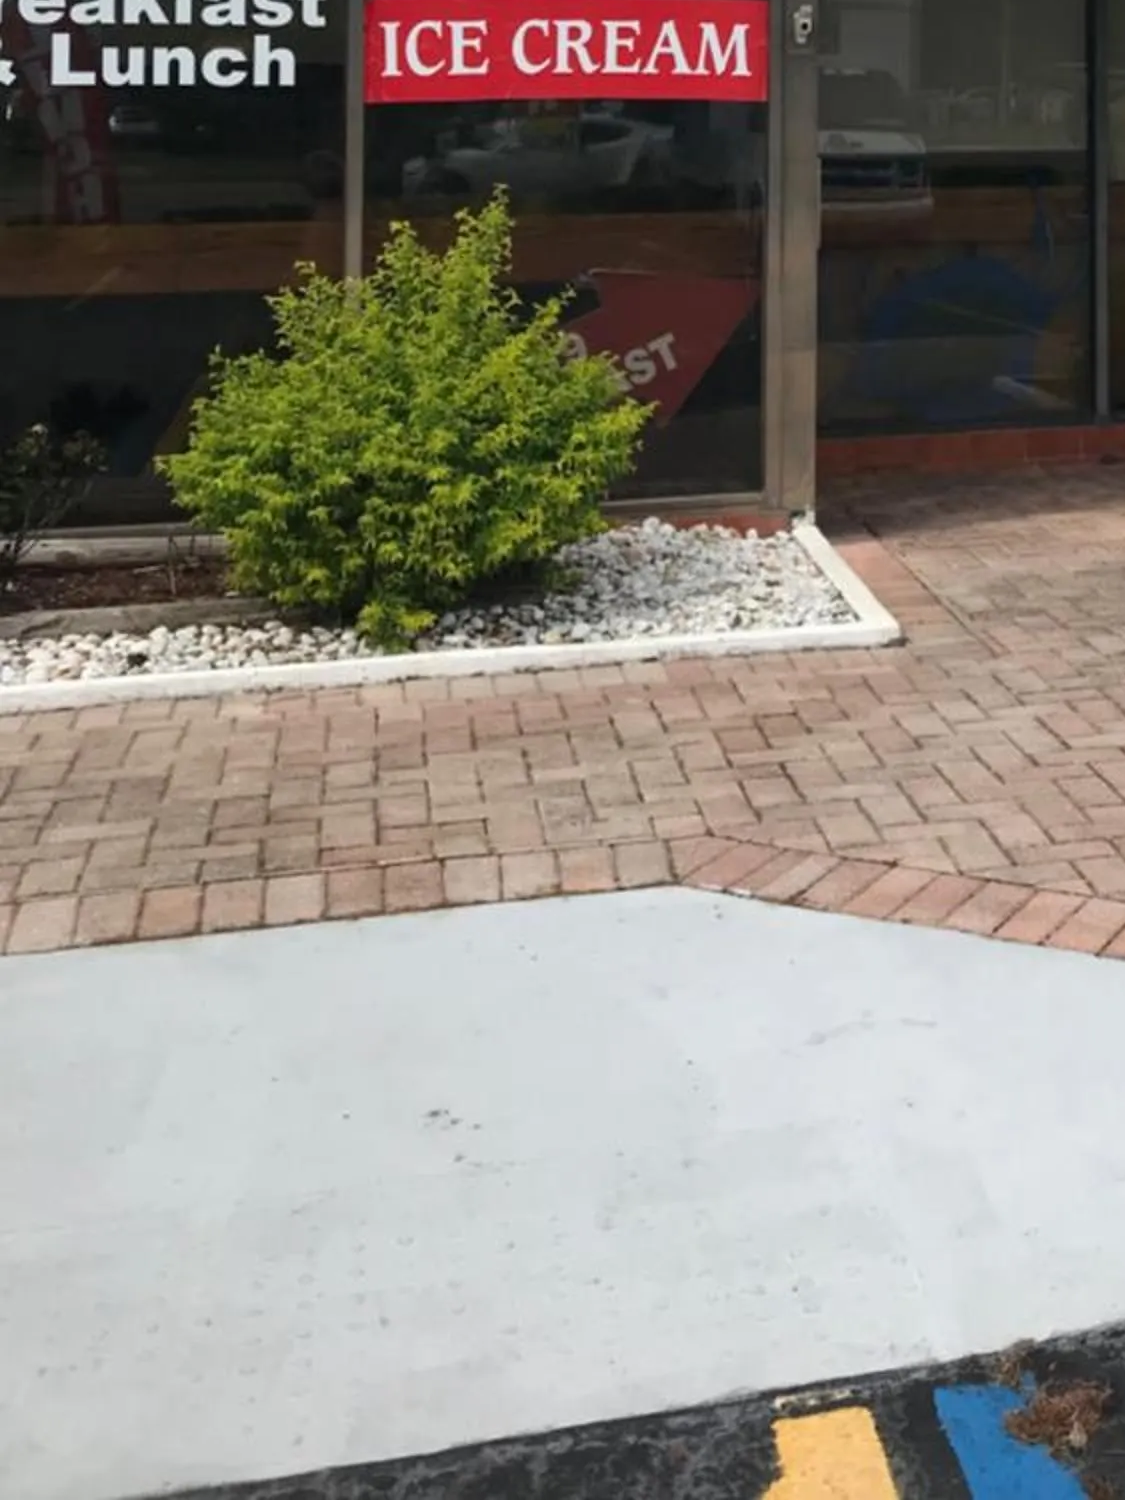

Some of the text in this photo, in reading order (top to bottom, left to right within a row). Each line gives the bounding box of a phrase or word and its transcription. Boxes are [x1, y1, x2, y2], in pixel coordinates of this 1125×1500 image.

[51, 33, 296, 88] Lunch
[379, 17, 752, 78] ICE CREAM
